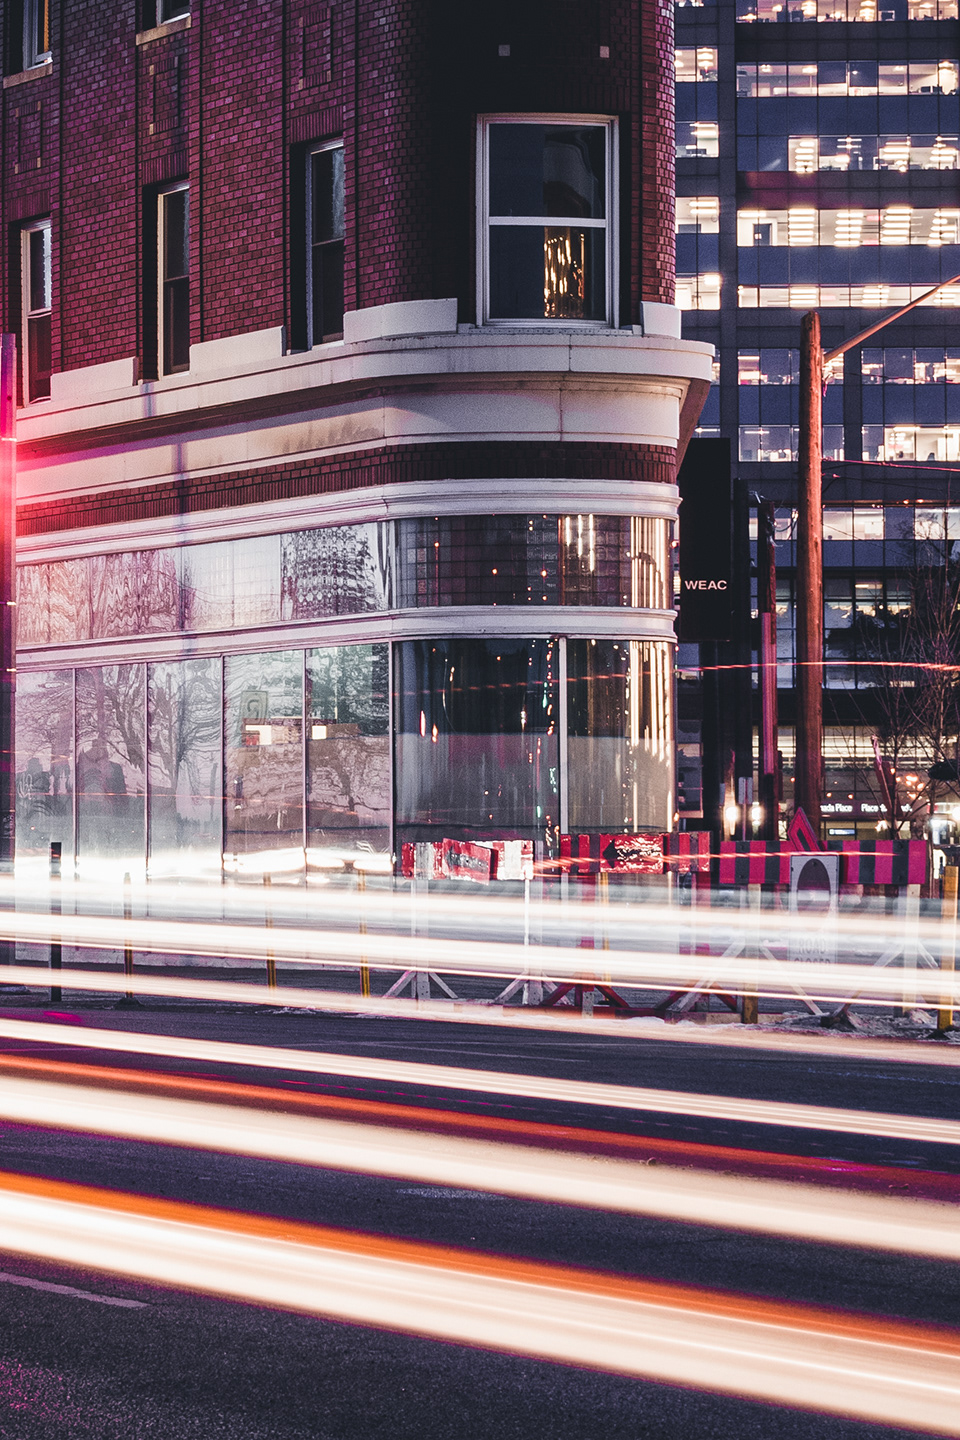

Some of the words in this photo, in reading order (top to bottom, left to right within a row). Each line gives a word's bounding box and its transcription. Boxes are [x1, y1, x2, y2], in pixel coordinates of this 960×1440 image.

[684, 580, 727, 590] WEAC
[835, 803, 853, 812] Place
[861, 803, 879, 812] Place
